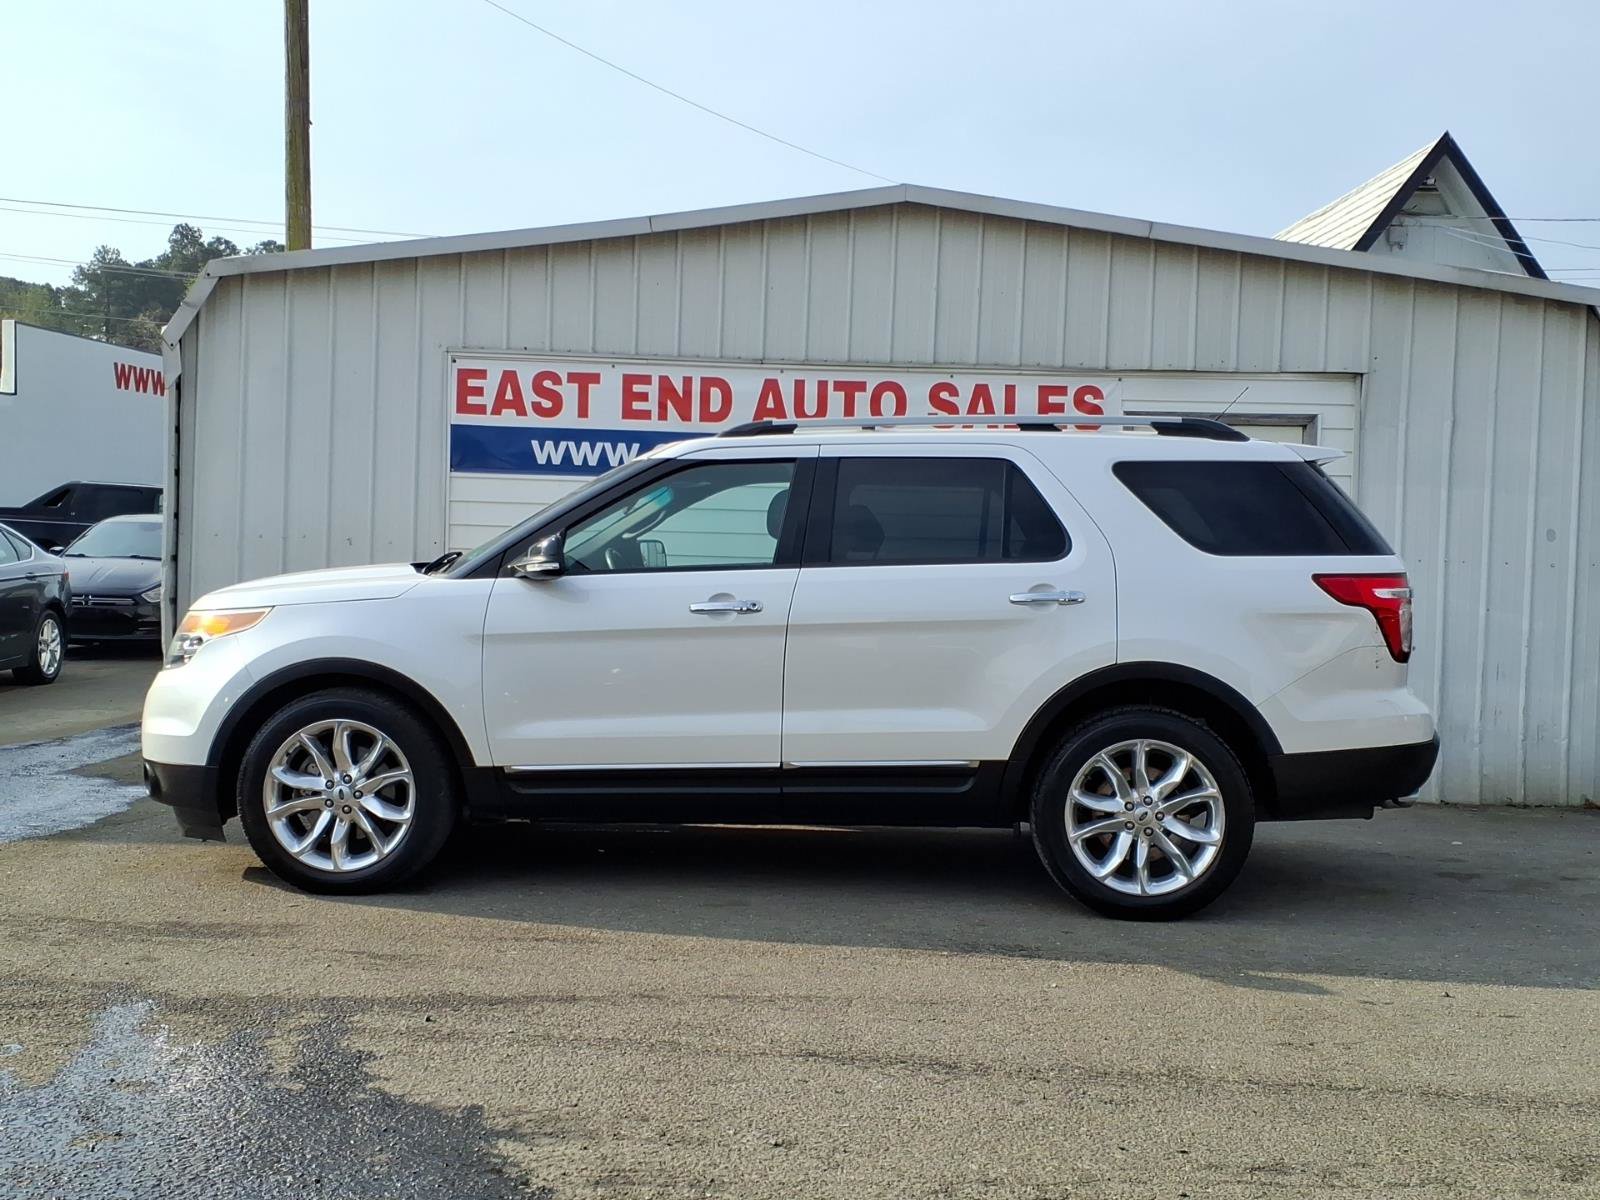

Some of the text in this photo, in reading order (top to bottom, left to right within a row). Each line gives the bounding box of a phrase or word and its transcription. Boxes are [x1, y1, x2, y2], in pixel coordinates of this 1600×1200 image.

[456, 368, 1105, 431] EAST END AUTO SALES
